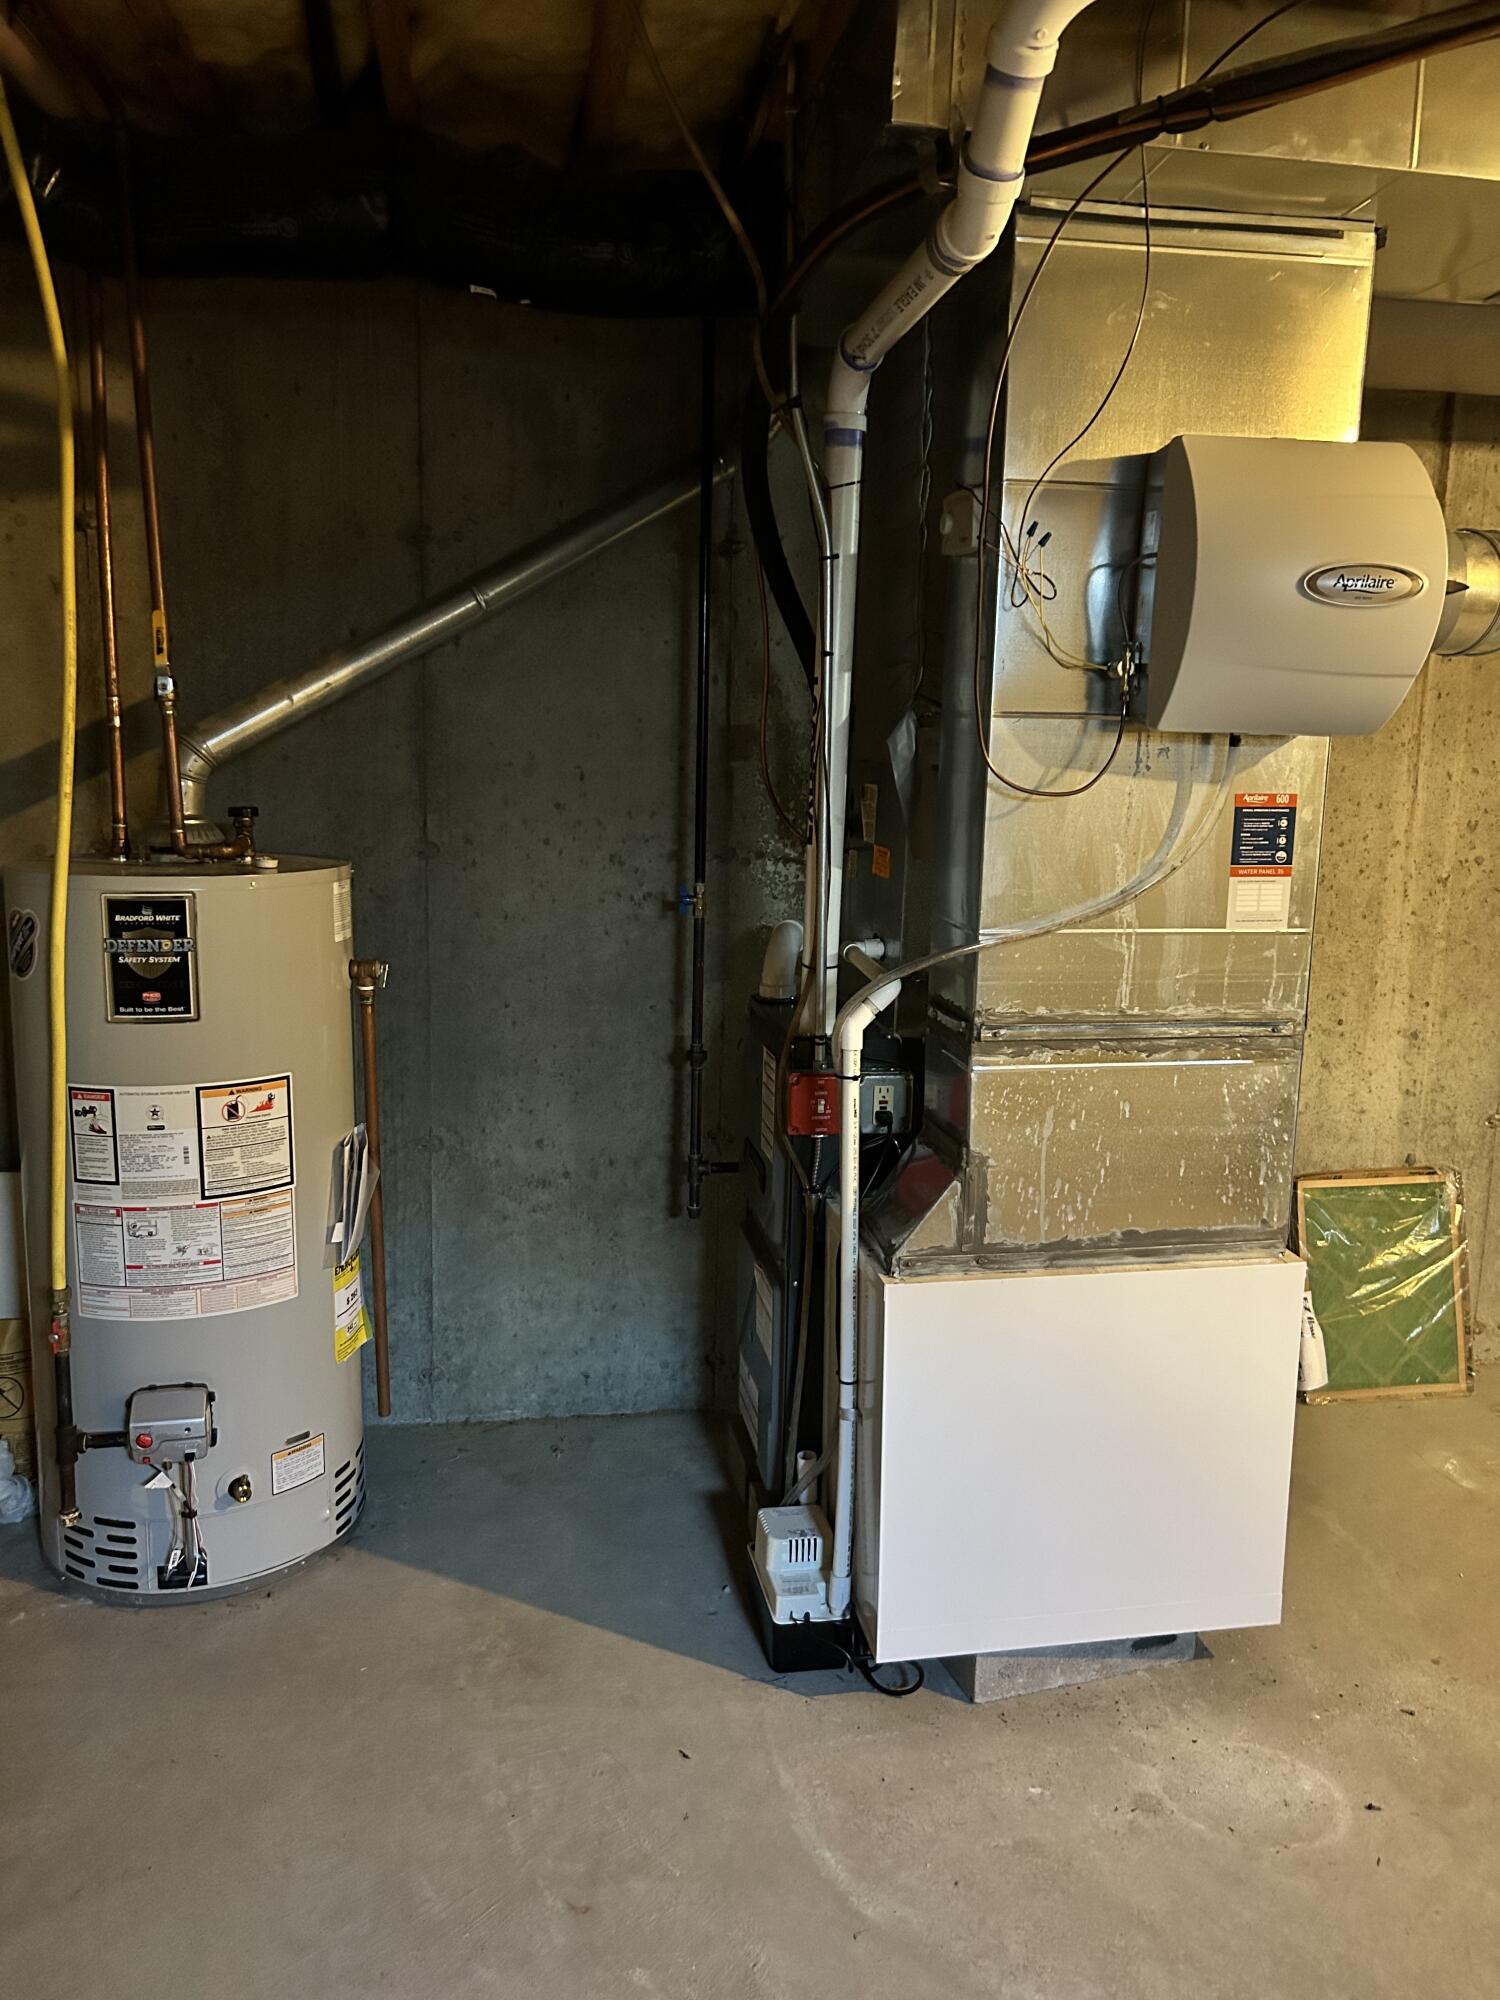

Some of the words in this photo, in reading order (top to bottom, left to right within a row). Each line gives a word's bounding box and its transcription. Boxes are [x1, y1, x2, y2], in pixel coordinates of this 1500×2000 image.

[893, 285, 919, 313] EAGLE
[1333, 573, 1395, 594] Aprilaire
[1242, 793, 1269, 804] Aprilaire
[1276, 794, 1290, 804] 600
[105, 939, 194, 952] DEFENDER
[235, 1086, 262, 1094] WARNING
